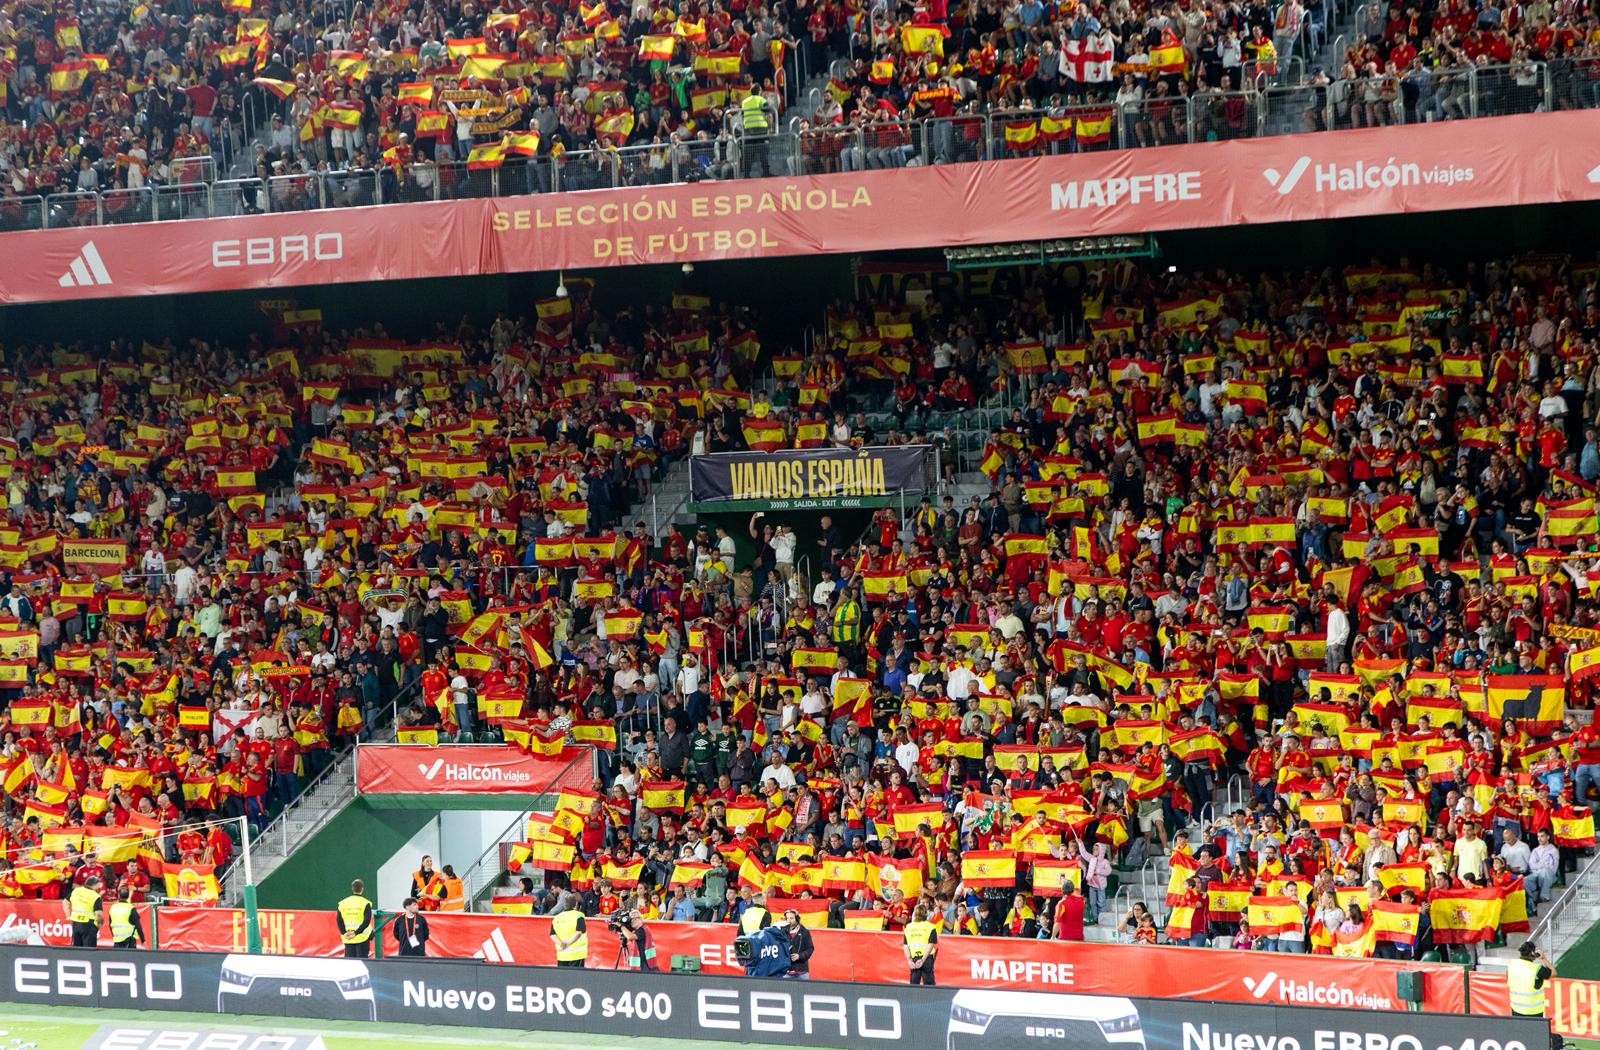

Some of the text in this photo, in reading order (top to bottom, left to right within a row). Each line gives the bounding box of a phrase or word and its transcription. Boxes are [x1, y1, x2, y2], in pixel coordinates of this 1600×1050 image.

[1051, 171, 1201, 210] MAPFRE
[1316, 157, 1474, 192] Halcón viajes
[493, 185, 872, 231] SELECCIÓN ESPAÑOLA
[212, 233, 342, 267] EBRO
[594, 226, 778, 259] DE FÚTBOL
[730, 450, 886, 498] VAMOS ESPAÑA
[793, 500, 817, 509] SALIDA
[822, 499, 837, 508] EXIT
[64, 547, 121, 559] BARCELONA
[445, 764, 530, 784] Halcón viajes
[233, 911, 296, 954] ECHE
[14, 957, 183, 1000] EBRO
[970, 959, 1074, 985] MAPFRE
[280, 986, 312, 997] EBRO
[403, 980, 672, 1021] Nuevo EBRO s400
[1280, 979, 1391, 1010] Halcón viajes
[697, 988, 902, 1040] EBRO
[1025, 1026, 1065, 1038] EBRO
